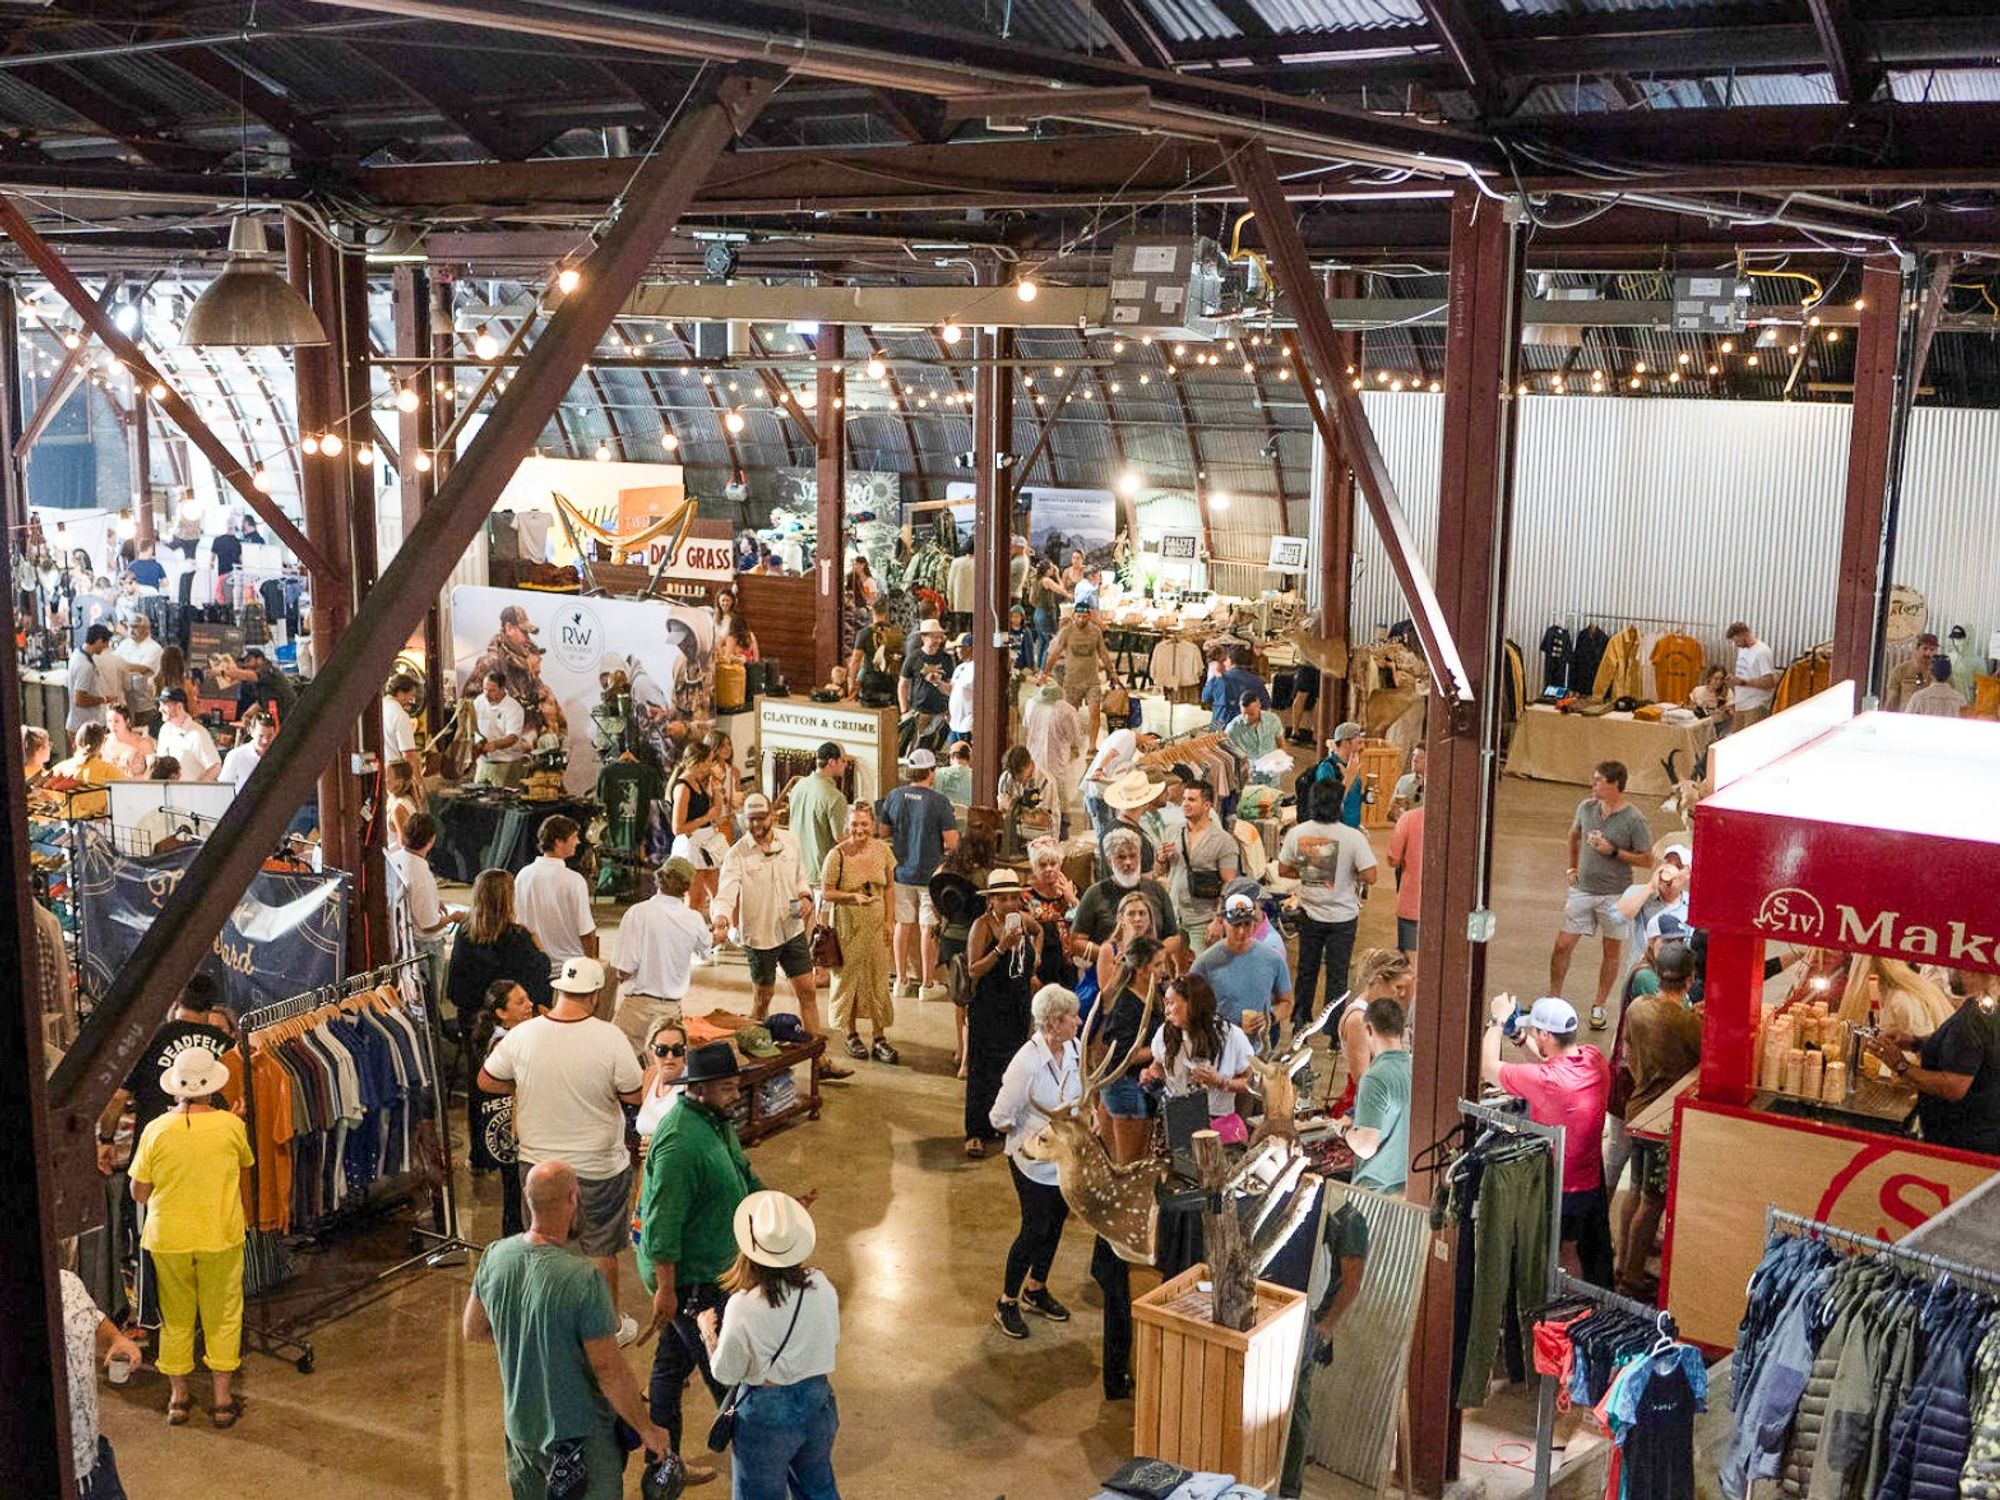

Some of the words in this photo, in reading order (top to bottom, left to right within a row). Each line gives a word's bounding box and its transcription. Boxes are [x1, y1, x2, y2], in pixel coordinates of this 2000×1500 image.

[687, 547, 731, 570] GRASS
[562, 626, 592, 646] RW
[762, 711, 817, 727] CLAYTON
[820, 719, 829, 729] &
[832, 719, 877, 735] CRUME
[1835, 903, 2000, 966] Mak
